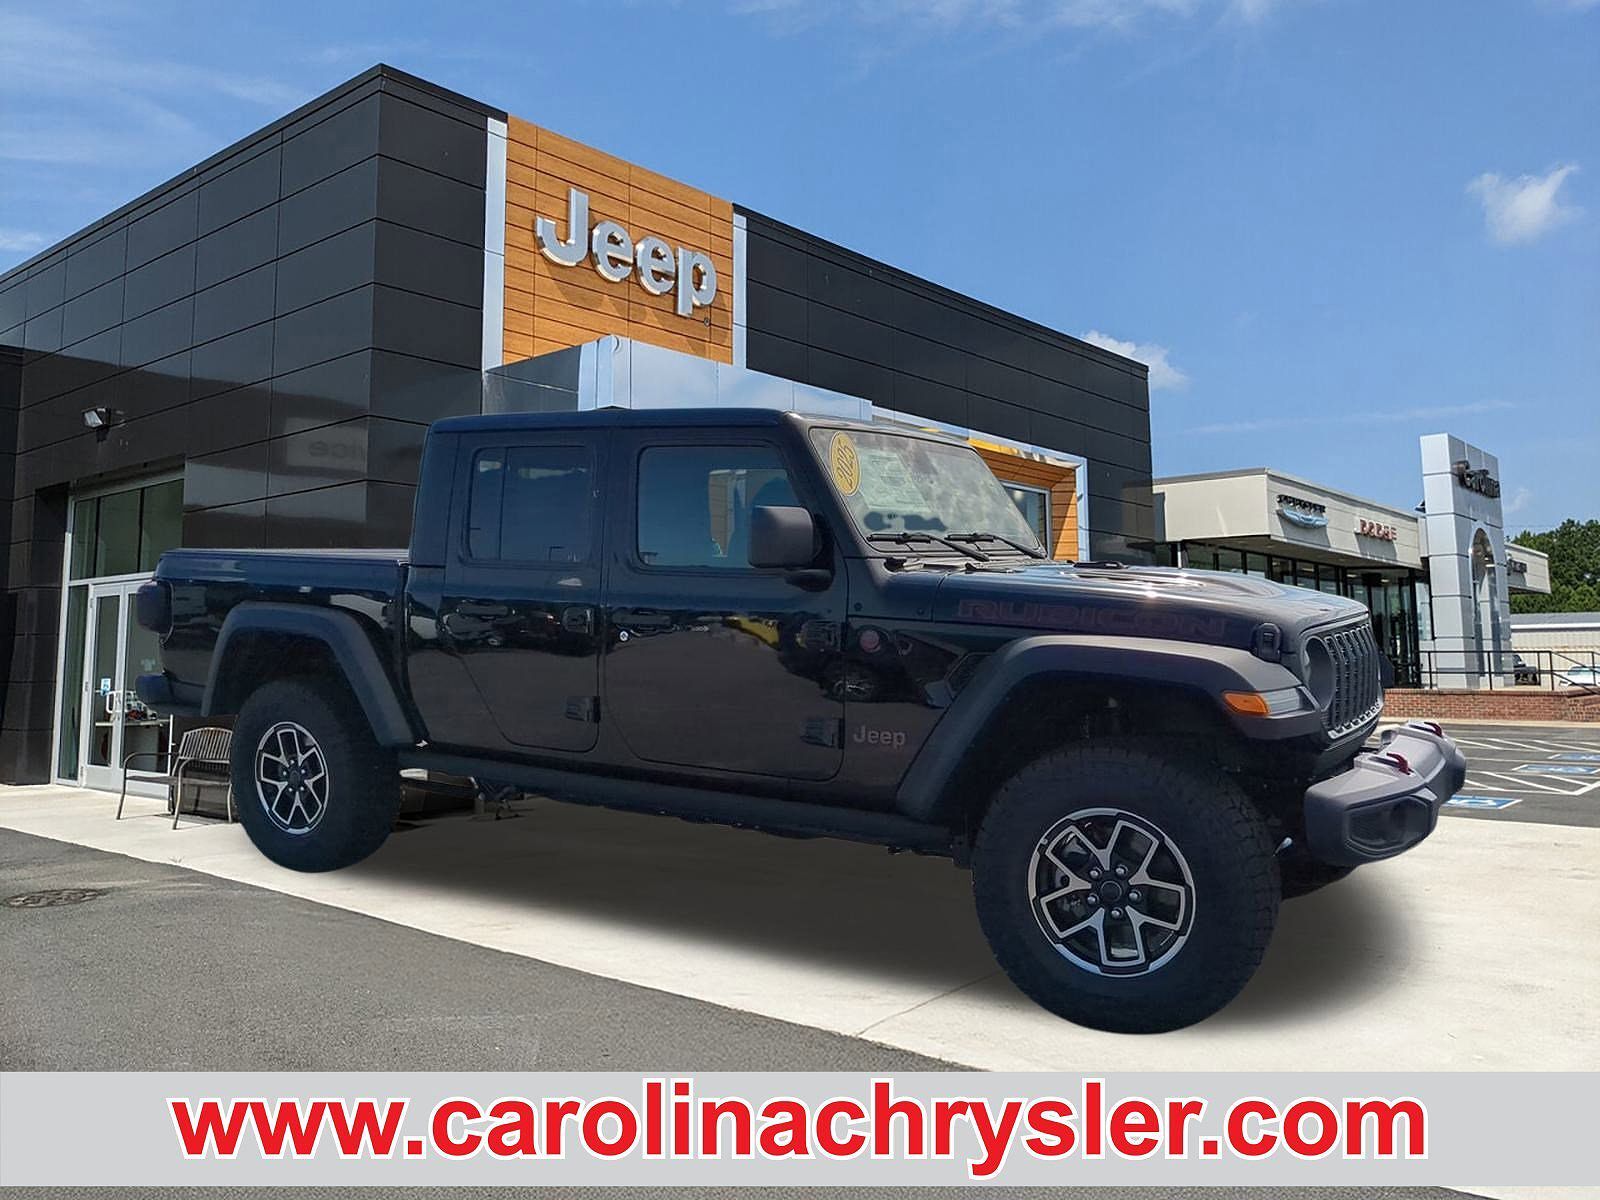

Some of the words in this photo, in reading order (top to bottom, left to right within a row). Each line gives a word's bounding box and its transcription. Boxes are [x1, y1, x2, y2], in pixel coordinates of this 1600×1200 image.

[535, 187, 717, 318] Jeep
[957, 600, 1227, 637] RUBICON
[853, 725, 906, 750] Jeep
